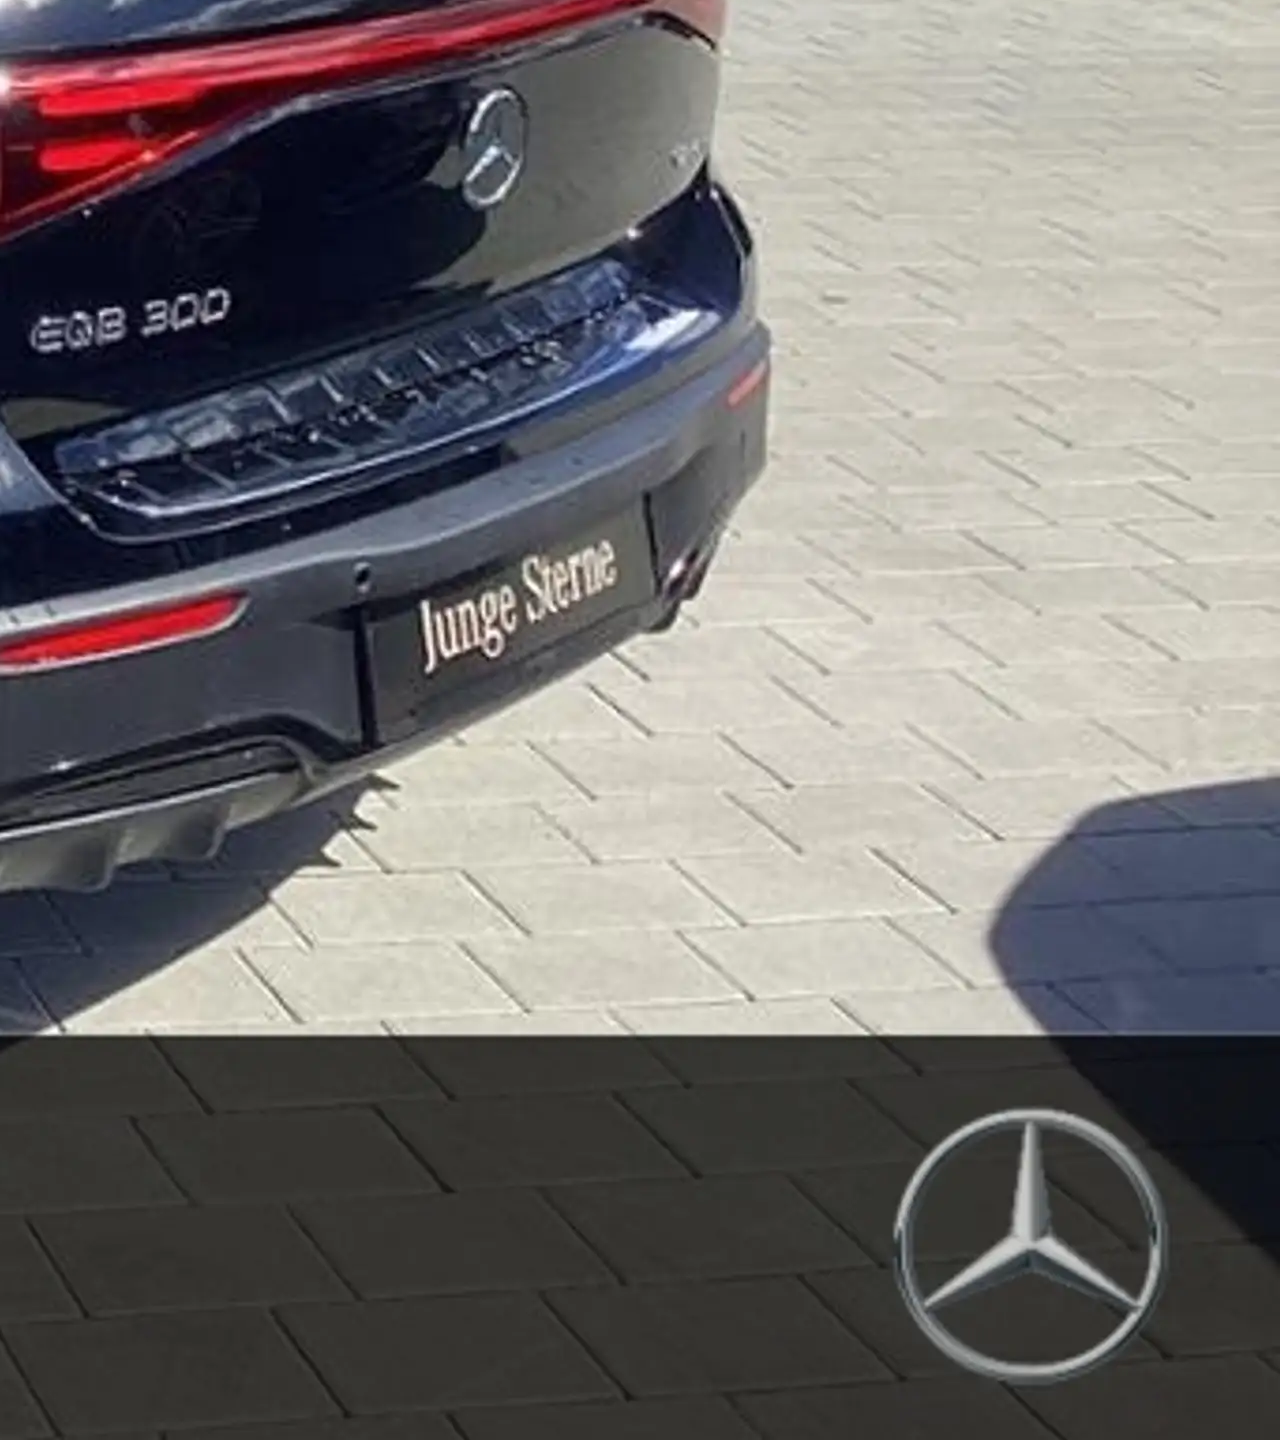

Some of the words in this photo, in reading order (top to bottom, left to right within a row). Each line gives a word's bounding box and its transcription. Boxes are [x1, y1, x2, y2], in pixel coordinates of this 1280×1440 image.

[30, 307, 126, 352] EQB
[141, 287, 231, 337] 300
[419, 584, 517, 674] Junge
[522, 539, 618, 624] Sterne
